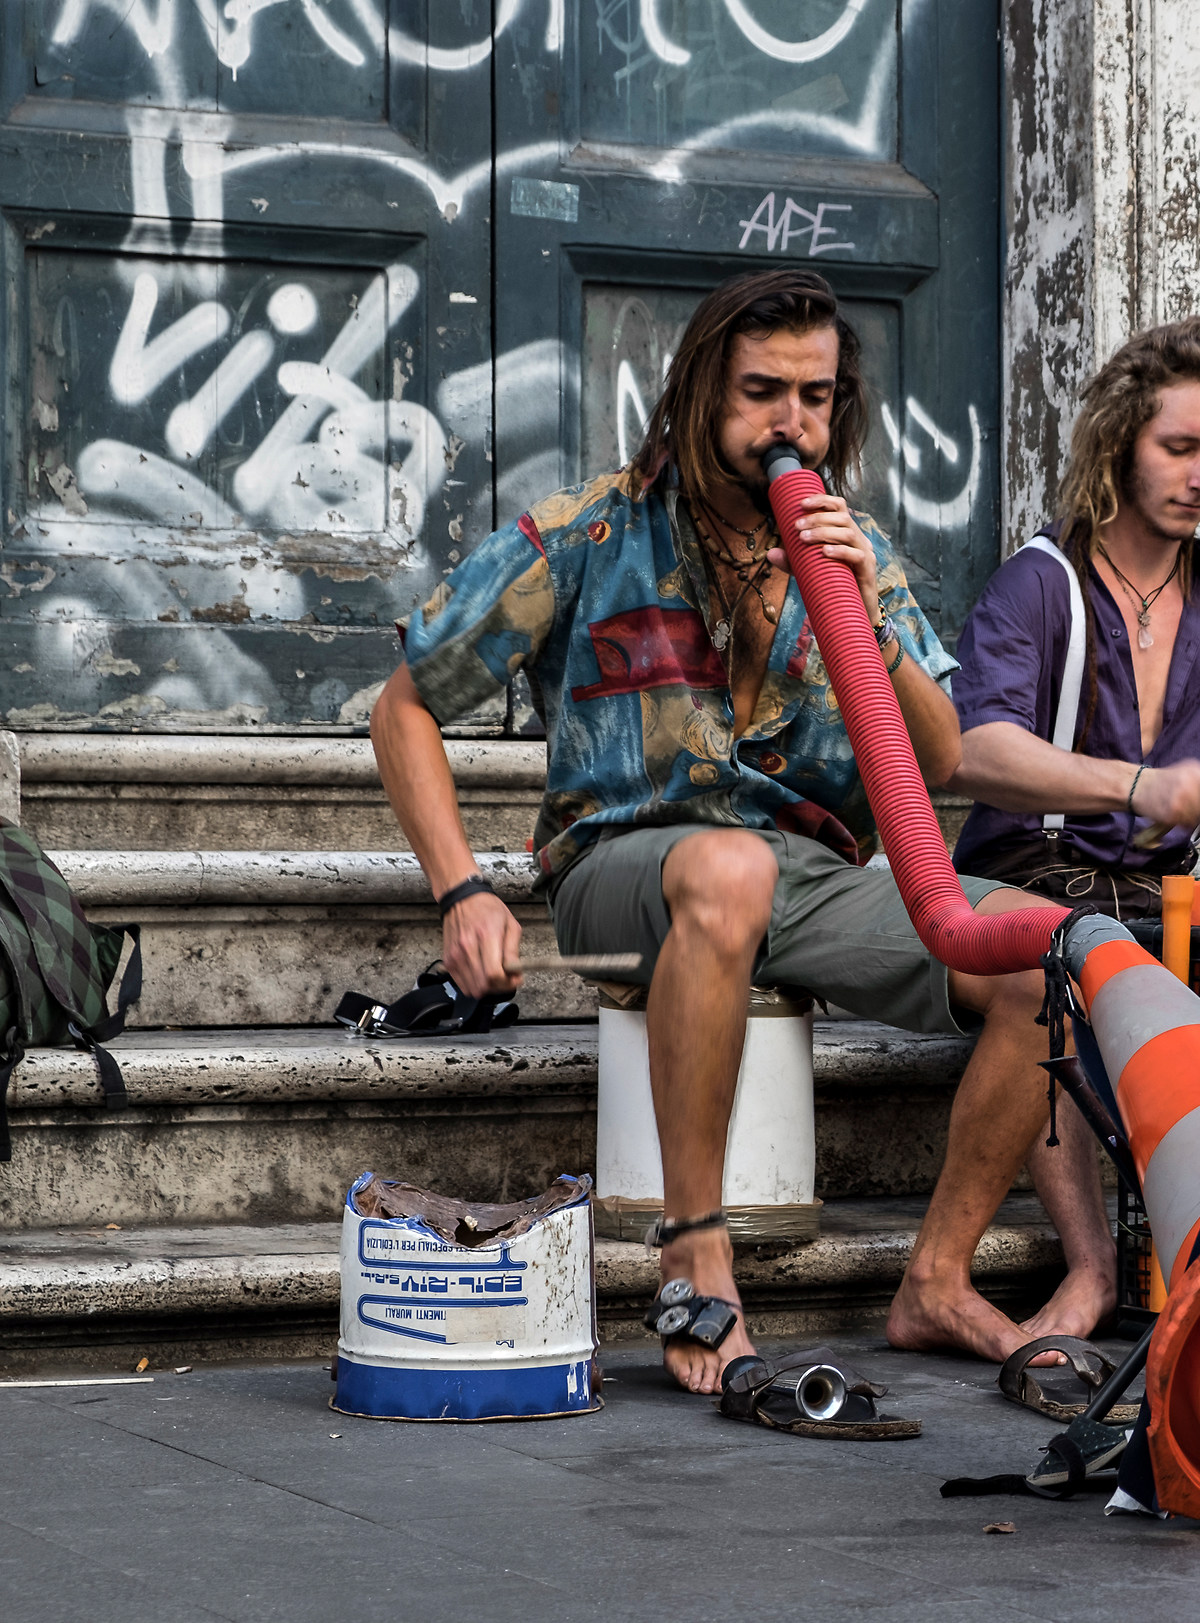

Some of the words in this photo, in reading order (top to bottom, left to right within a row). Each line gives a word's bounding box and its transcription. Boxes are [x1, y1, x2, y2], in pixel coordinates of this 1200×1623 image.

[738, 191, 855, 256] APE
[401, 1239, 416, 1251] PER
[385, 1307, 412, 1319] MURALI
[416, 1309, 447, 1321] TIMENTI
